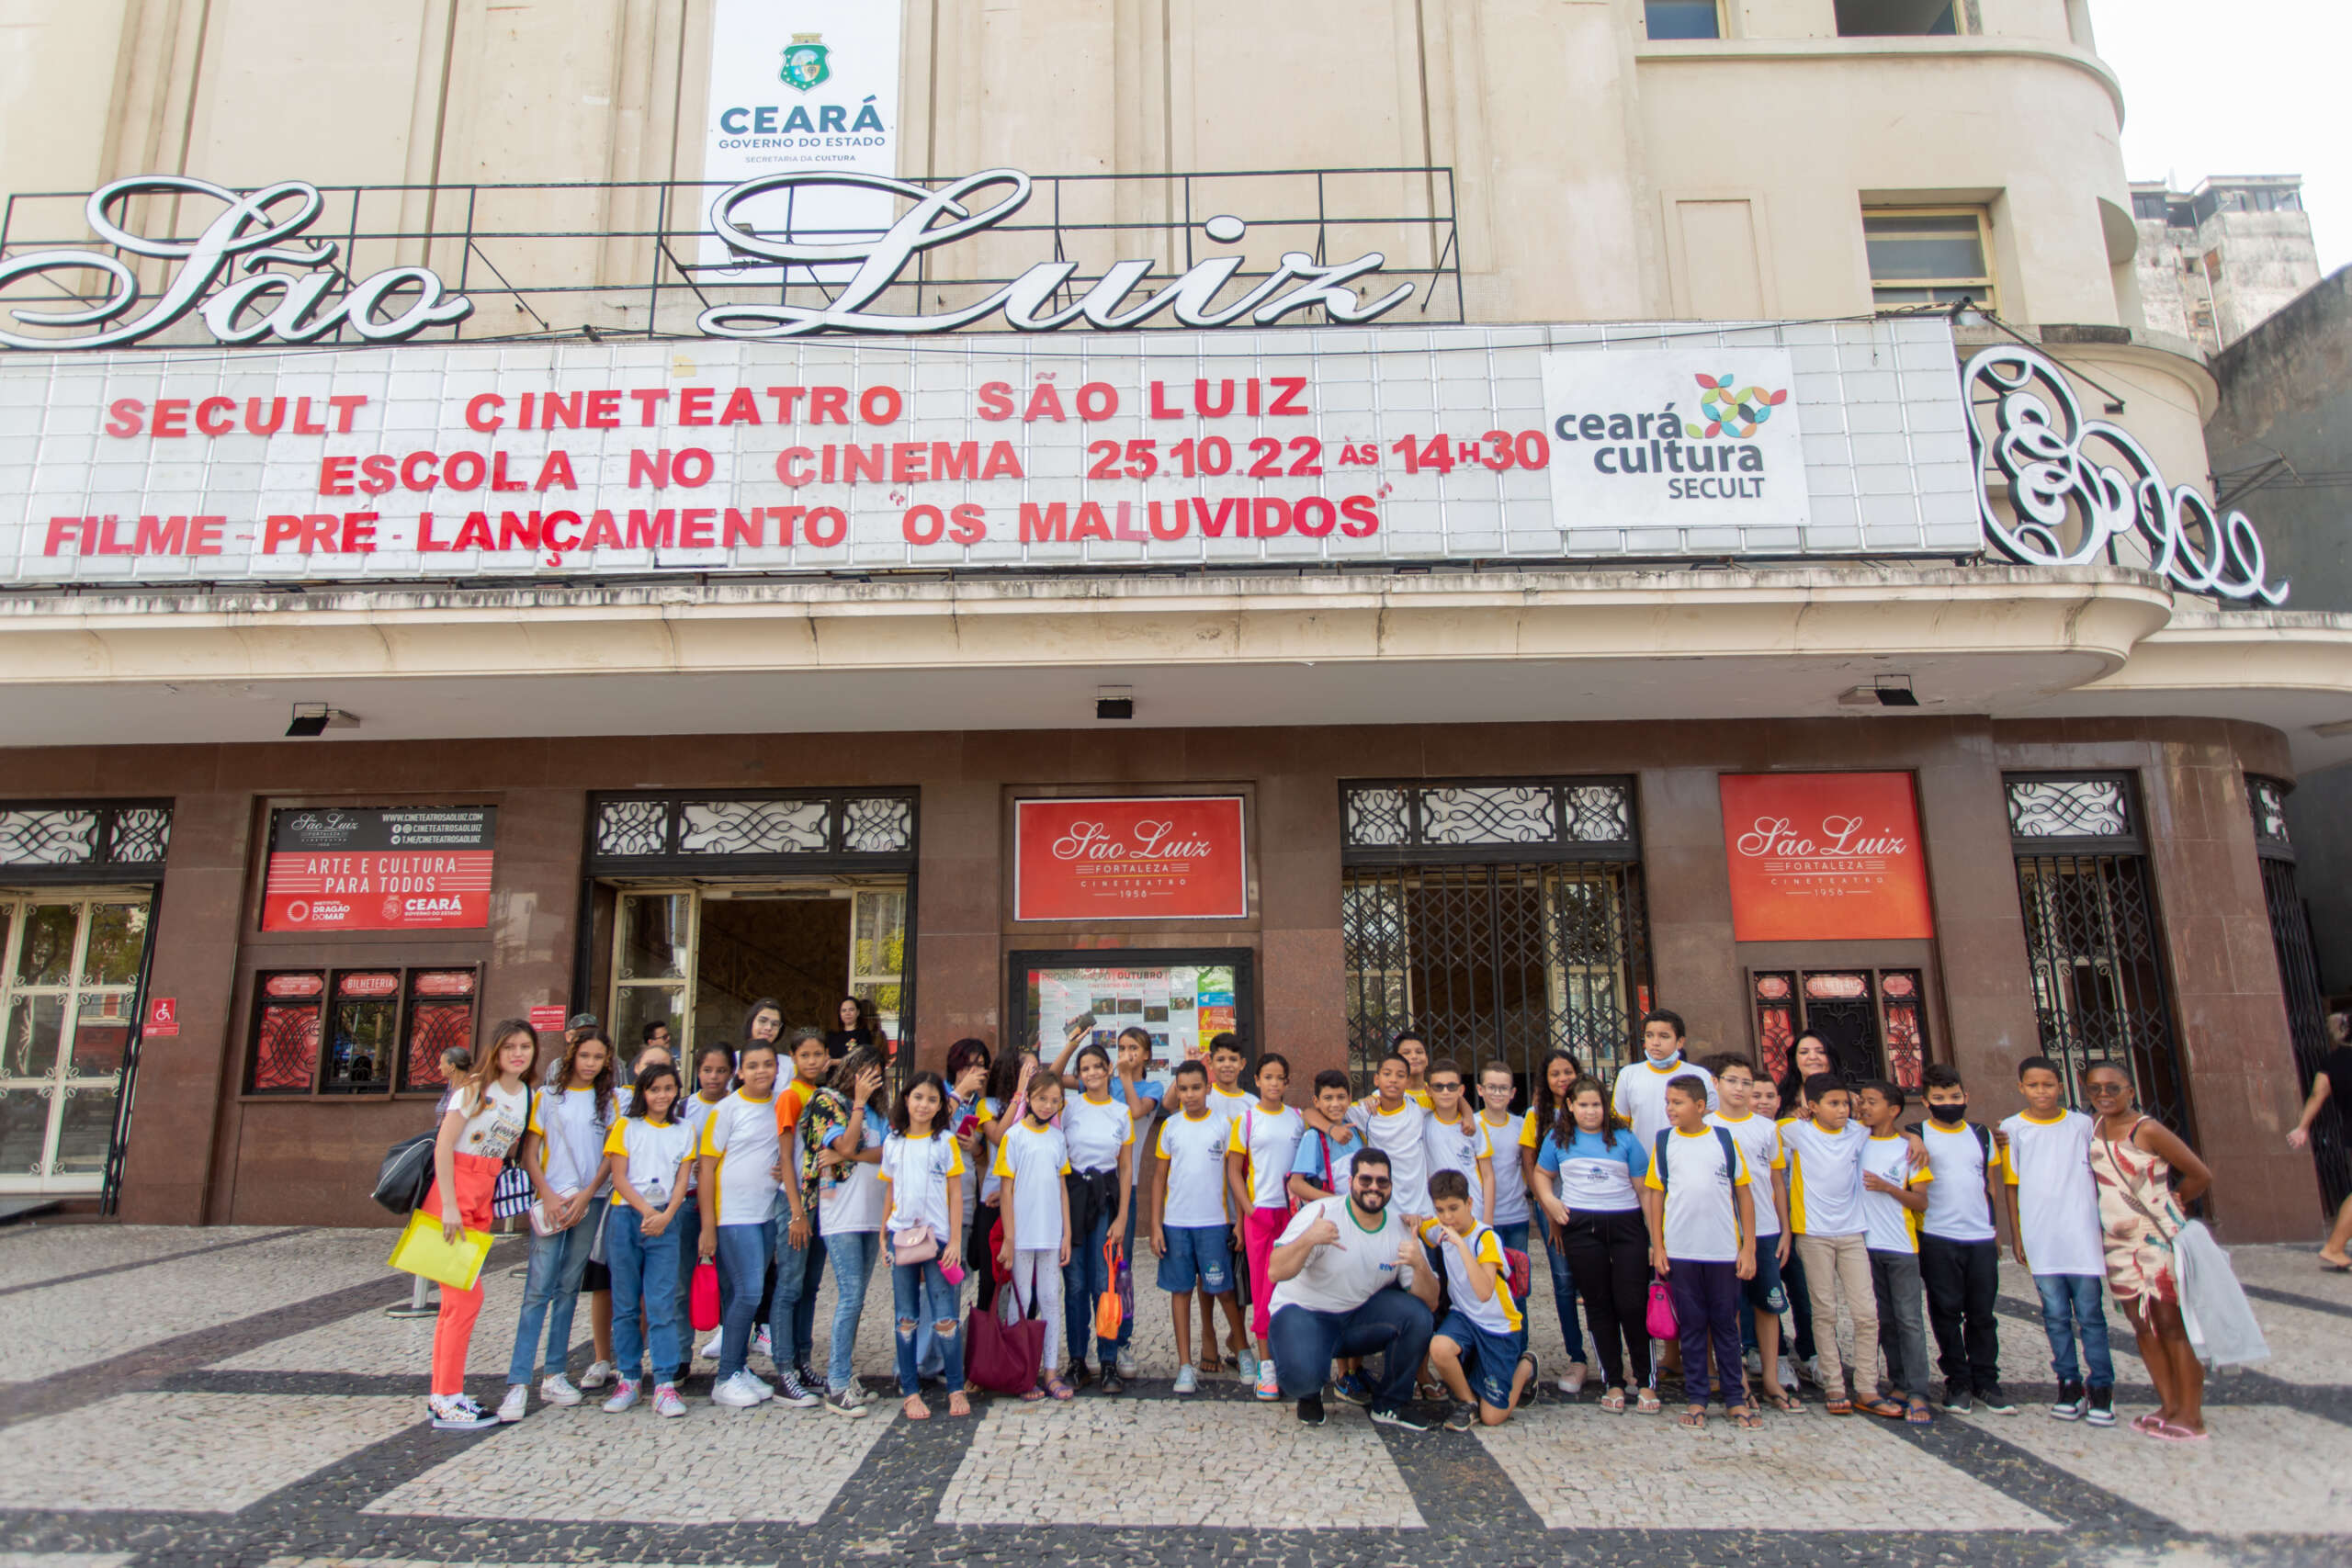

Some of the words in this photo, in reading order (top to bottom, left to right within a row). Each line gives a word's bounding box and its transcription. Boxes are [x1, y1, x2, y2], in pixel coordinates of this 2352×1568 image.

[720, 95, 885, 135] CEARÁ
[718, 138, 794, 149] GOVERNO
[798, 138, 820, 148] DO
[826, 137, 885, 147] ESTADO
[0, 175, 476, 349] São
[696, 167, 1416, 338] Luiz
[106, 395, 368, 437] SECULT
[466, 386, 903, 432] CINETEATRO
[978, 372, 1119, 422] SÃO
[1151, 377, 1309, 419] LUIZ
[1555, 402, 1683, 441] ceará
[319, 449, 578, 496] ESCOLA
[628, 448, 715, 489] NO
[776, 441, 1024, 486] CINEMA
[1088, 436, 1324, 479] 25.10.22
[1338, 435, 1379, 466] ÀS
[1594, 439, 1762, 475] cultura
[1668, 478, 1765, 499] SECULT
[44, 514, 227, 556] FILME
[417, 505, 848, 567] LANÇAMENTO
[291, 813, 322, 830] São
[323, 813, 360, 830] Luiz
[1052, 820, 1126, 860] São
[1129, 819, 1212, 859] Luiz
[1737, 816, 1815, 857] São
[1820, 815, 1907, 856] Luiz
[307, 858, 353, 874] ARTE
[361, 858, 369, 874] E
[379, 857, 457, 874] CULTURA
[1095, 863, 1170, 874] FORTALEZA
[1785, 861, 1864, 871] FORTALEZA
[324, 877, 369, 894] PARA
[380, 876, 435, 893] TODOS
[1080, 878, 1186, 887] CINETEATRO
[1770, 876, 1883, 886] CINETEATRO
[1815, 887, 1844, 897] 1958
[405, 895, 462, 910] CEARÁ
[347, 978, 393, 989] BILHETERIA
[1117, 971, 1163, 980] OUTUBRO
